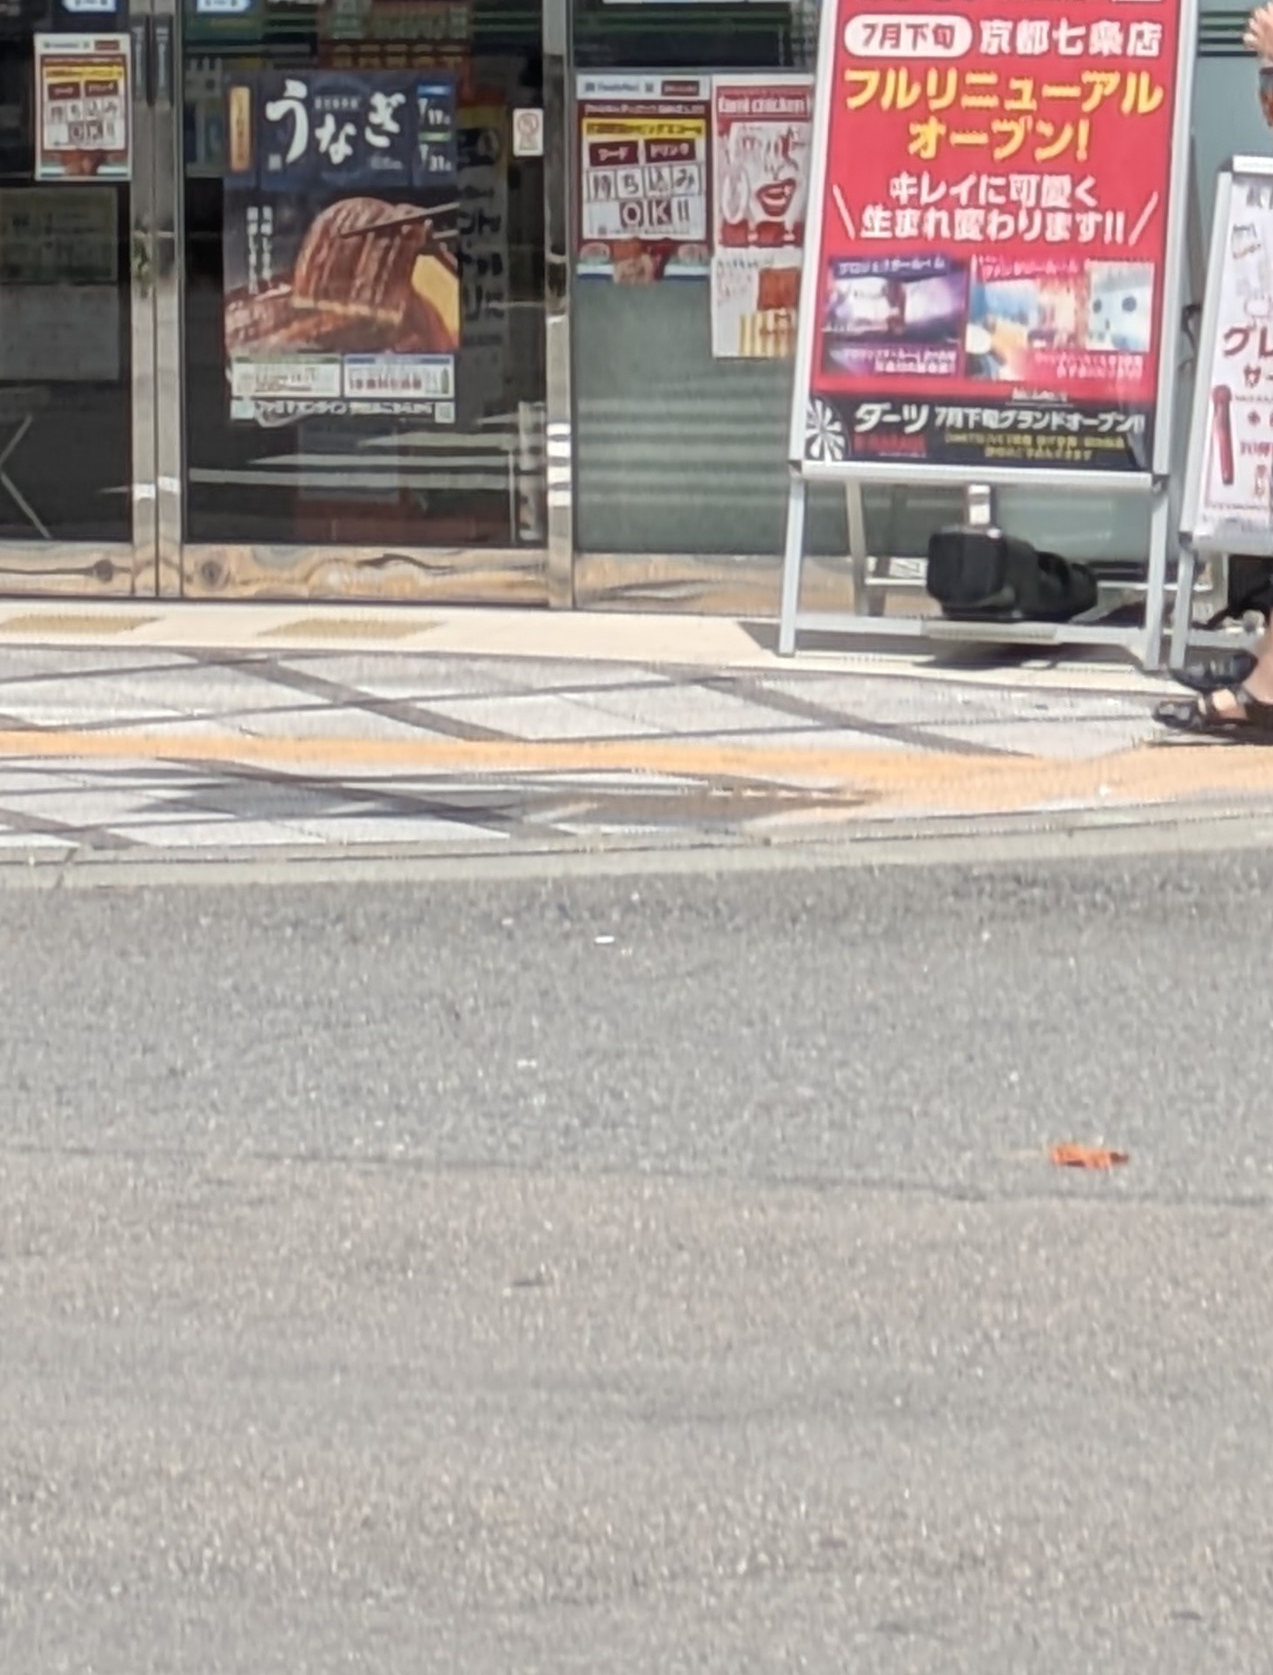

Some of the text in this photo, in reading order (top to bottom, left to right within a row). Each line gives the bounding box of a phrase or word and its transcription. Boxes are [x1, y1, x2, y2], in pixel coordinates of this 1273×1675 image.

[843, 66, 1164, 115] フルリニューアル
[265, 78, 407, 165] うなぎ
[908, 115, 1090, 163] オープン!
[889, 171, 1098, 209] キレイに可愛く
[854, 402, 930, 434] ダーツ
